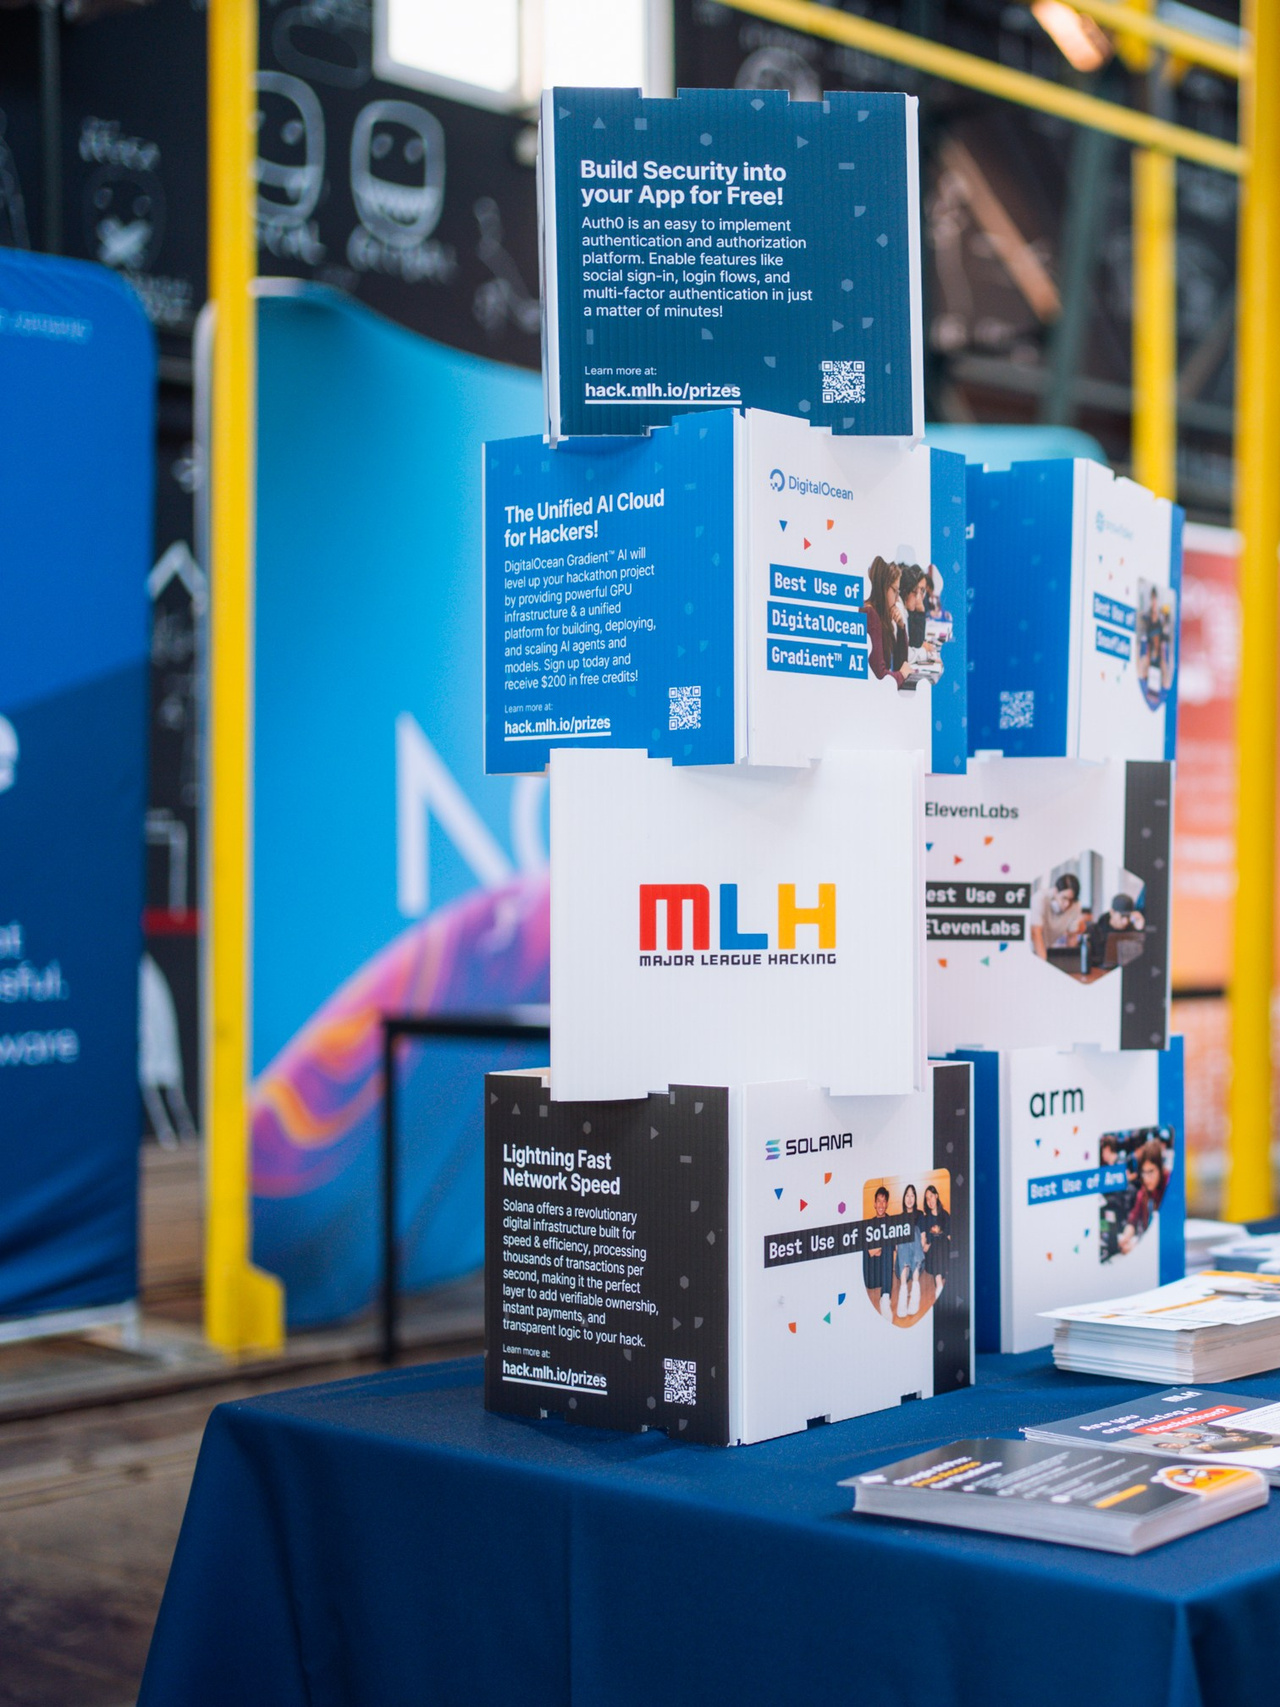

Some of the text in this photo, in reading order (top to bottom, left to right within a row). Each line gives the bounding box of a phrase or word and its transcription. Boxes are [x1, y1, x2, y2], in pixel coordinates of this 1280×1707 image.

[581, 159, 787, 186] Build Security into
[581, 185, 784, 209] your App for Free!
[582, 216, 791, 234] Auth0 is an easy to implement
[582, 234, 807, 249] authentication and authorization
[583, 252, 784, 267] platform. Enable features like
[583, 269, 790, 286] social sign-in, login flows, and
[583, 286, 813, 304] multi-factor authentication in just
[584, 304, 723, 318] a matter of minutes!
[585, 366, 657, 376] Learn more at:
[585, 382, 741, 401] hack.mlh.io/prizes
[789, 475, 854, 501] DigitalOcean
[504, 488, 665, 524] The Unified AI Cloud
[504, 520, 598, 548] for Hackers!
[504, 547, 646, 575] DigitalOcean Gradient™ AI will
[504, 564, 655, 590] level up your hackathon project
[774, 572, 860, 599] Best Use of
[504, 583, 633, 609] by providing powerful GPU
[504, 602, 622, 623] infrastructure & a unified
[772, 609, 865, 636] DigitalOcean
[504, 617, 656, 642] platform for building, deploying,
[504, 636, 627, 657] and scaling AI agents and
[771, 646, 864, 672] Gradient™ AI
[505, 653, 631, 674] models. Sign up today and
[504, 670, 638, 690] receive $200 in free credits!
[504, 703, 554, 714] Learn more at:
[505, 716, 611, 734] hack.mlh.io/prizes
[925, 802, 1019, 820] ElevenLabs
[925, 887, 1027, 904] est Use of
[640, 883, 836, 951] MLH
[925, 919, 1021, 936] ElevenLabs
[640, 953, 837, 967] MAJOR LEAGUE HACKING
[1029, 1087, 1085, 1119] arm
[786, 1133, 853, 1156] SOLANA
[503, 1144, 612, 1171] Lightning Fast
[503, 1167, 621, 1196] Network Speed
[1030, 1181, 1057, 1199] Best
[1062, 1178, 1082, 1194] Use
[1086, 1174, 1101, 1190] of
[503, 1199, 638, 1226] Solana offers a revolutionary
[503, 1216, 637, 1240] digital infrastructure built for
[503, 1235, 647, 1262] speed & efficiency, processing
[769, 1222, 911, 1260] Best Use of Solana
[503, 1250, 644, 1278] thousands of transactions per
[503, 1269, 641, 1294] second, making it the perfect
[503, 1284, 659, 1316] layer to add verifiable ownership,
[503, 1300, 606, 1325] instant payments, and
[503, 1318, 646, 1348] transparent logic to your hack.
[503, 1344, 551, 1359] Learn more at:
[503, 1361, 607, 1388] hack.mlh.io/prizes
